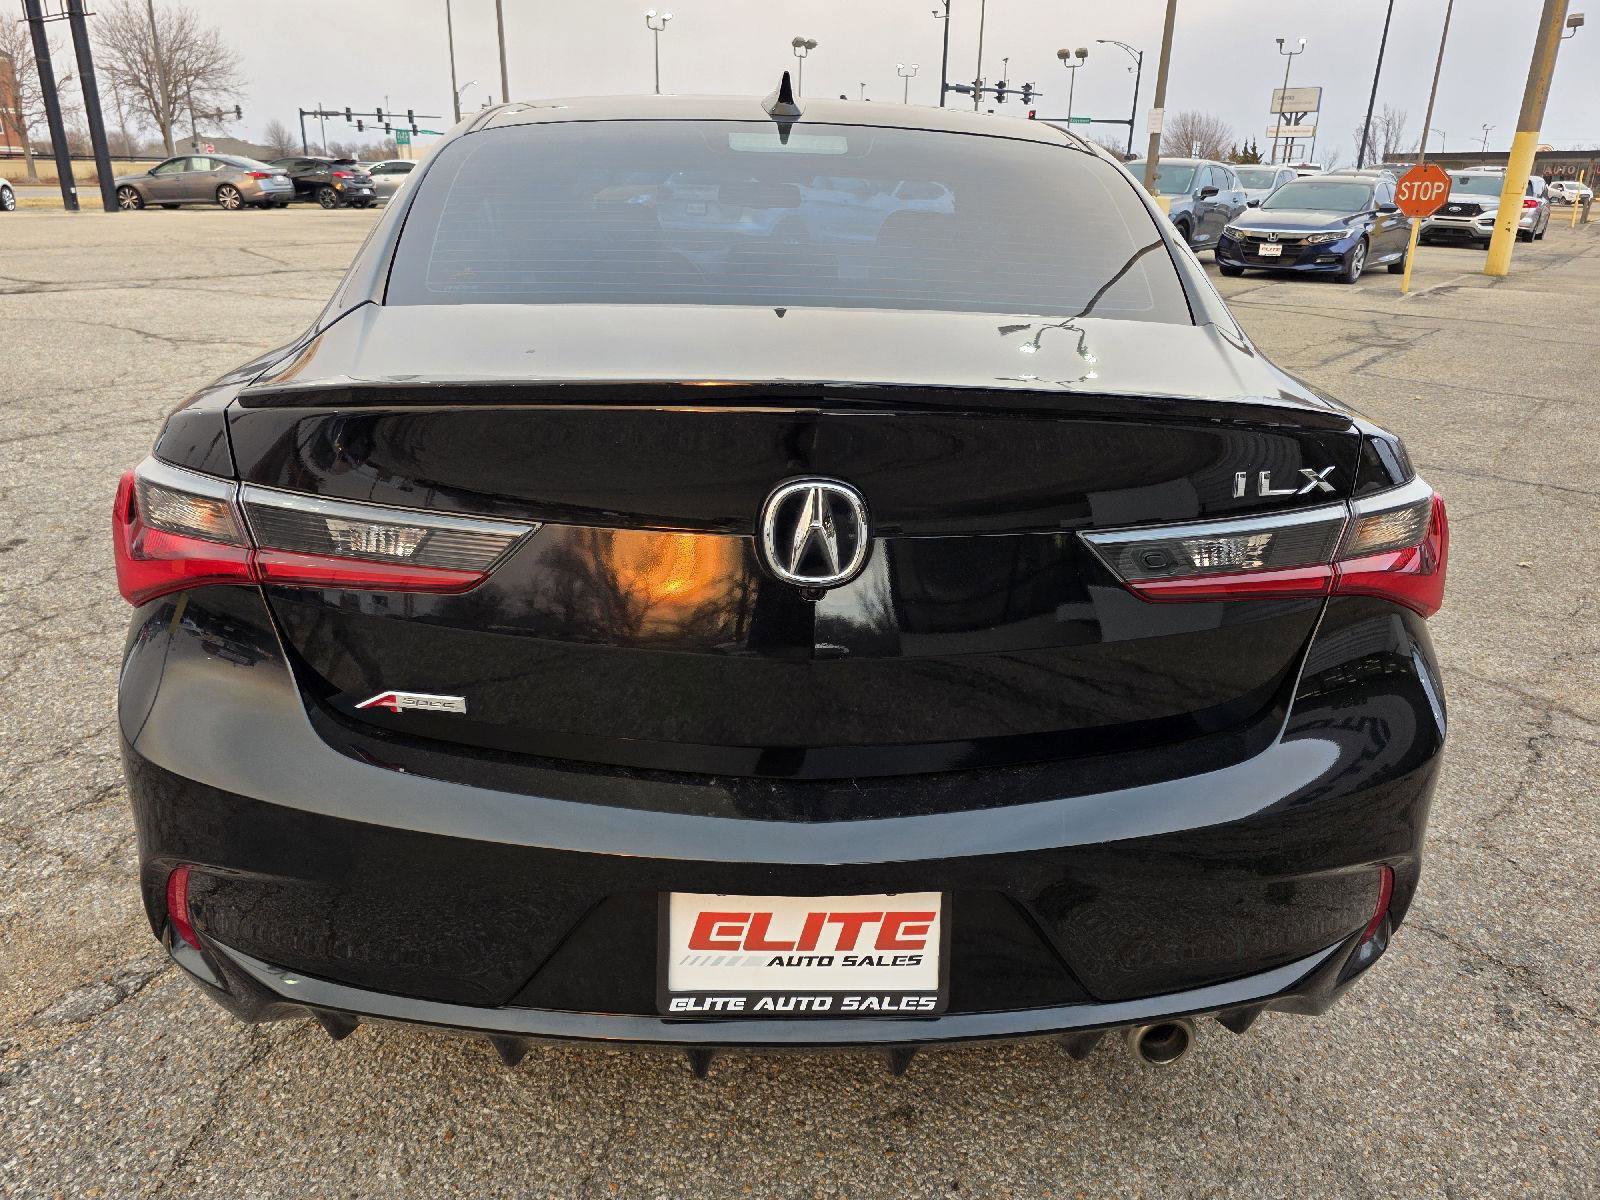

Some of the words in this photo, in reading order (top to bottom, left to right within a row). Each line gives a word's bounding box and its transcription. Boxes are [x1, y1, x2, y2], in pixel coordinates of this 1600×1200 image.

[1398, 181, 1444, 201] STOP
[1234, 465, 1336, 498] ILX
[687, 911, 936, 951] ELITE
[767, 955, 834, 967] AUTO
[841, 954, 924, 967] SALES
[669, 997, 747, 1012] ELITE
[753, 997, 832, 1011] AUTO
[840, 996, 937, 1011] SALES
